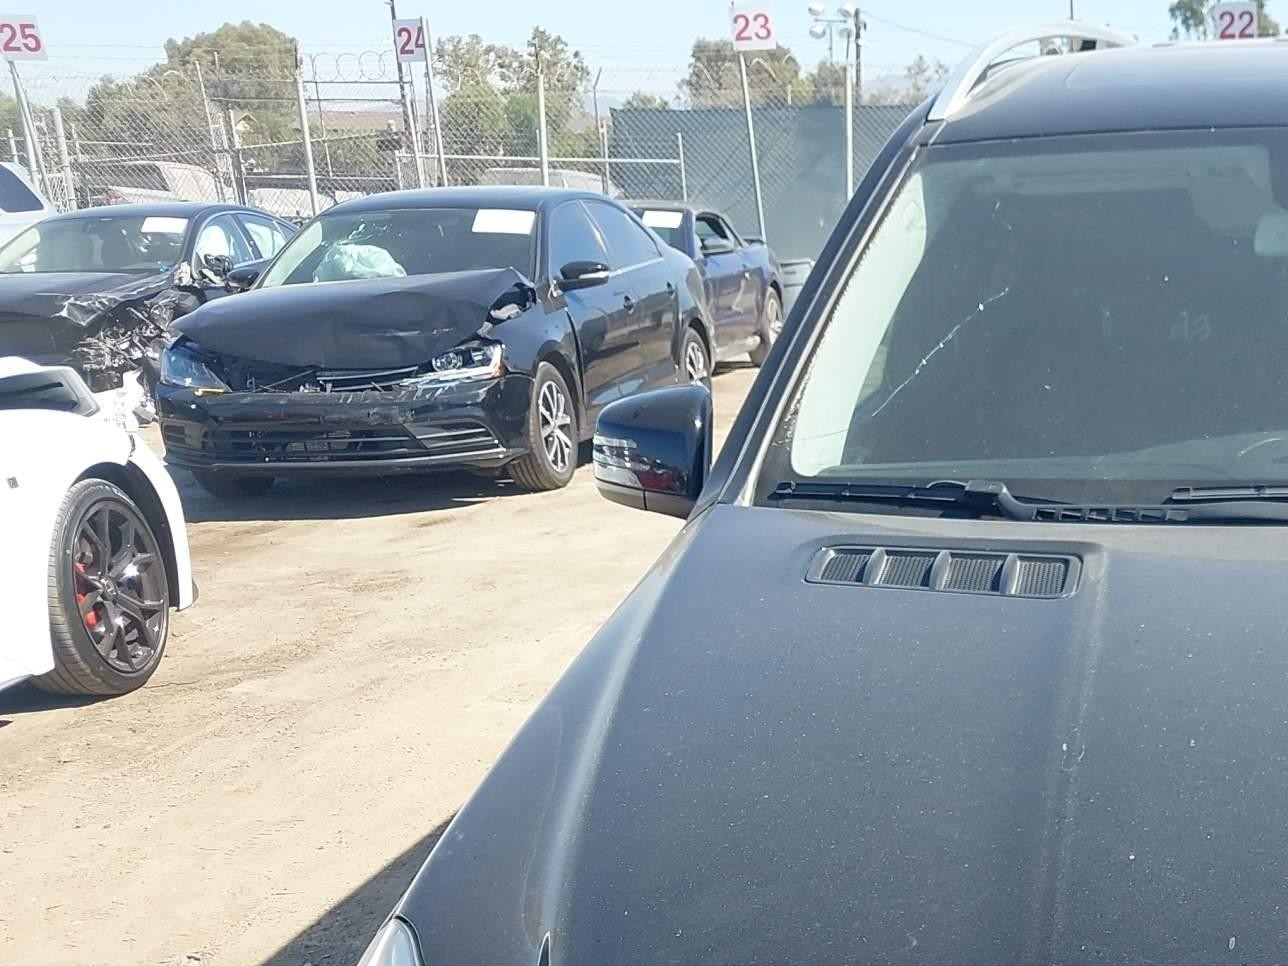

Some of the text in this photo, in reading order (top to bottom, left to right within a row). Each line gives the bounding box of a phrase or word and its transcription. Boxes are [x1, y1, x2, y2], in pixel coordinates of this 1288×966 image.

[0, 23, 41, 52] 25
[733, 13, 771, 41] 23
[1219, 11, 1254, 39] 22
